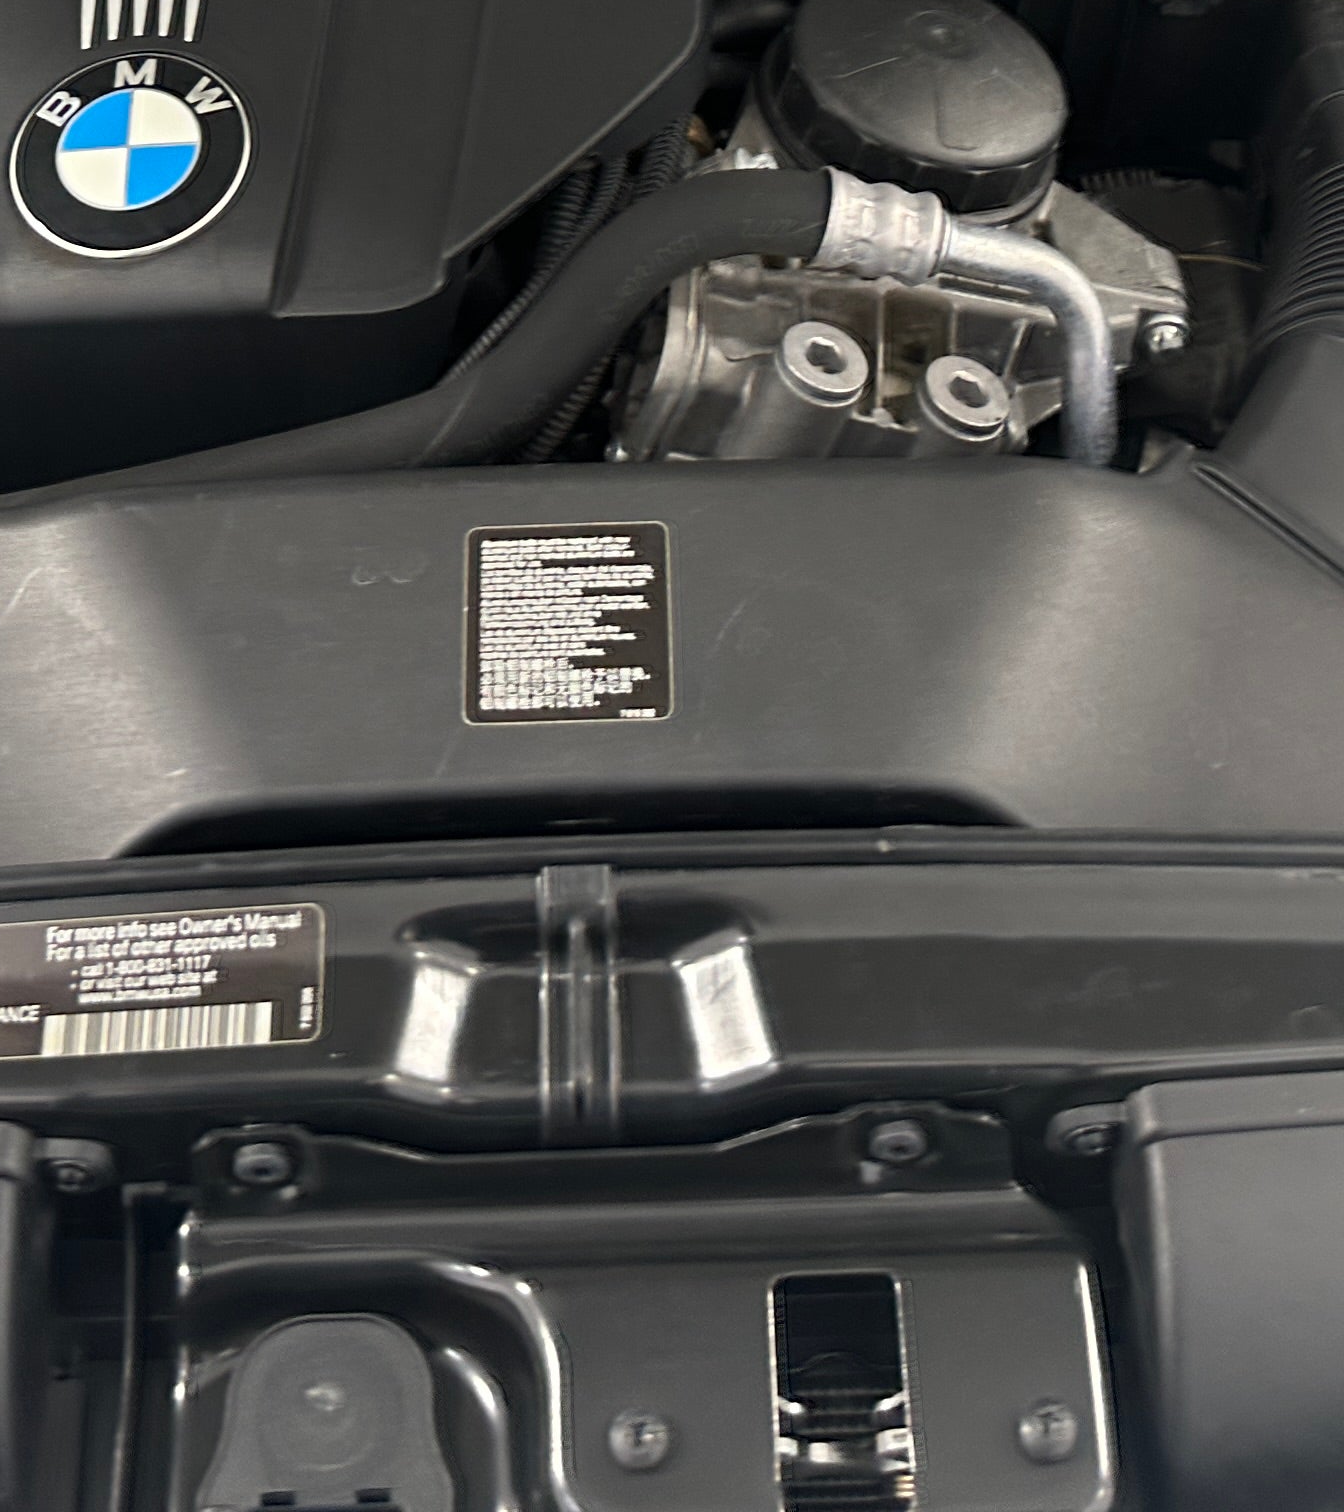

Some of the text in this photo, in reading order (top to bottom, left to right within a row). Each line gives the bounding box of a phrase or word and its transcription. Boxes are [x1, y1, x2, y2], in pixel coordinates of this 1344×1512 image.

[36, 57, 233, 126] BMW
[46, 911, 302, 944] For more info see Owner's Manual
[46, 944, 73, 962] For
[73, 946, 86, 960] a
[87, 941, 110, 959] list
[111, 939, 130, 957] of
[173, 934, 247, 954] approved
[249, 933, 277, 948] oils
